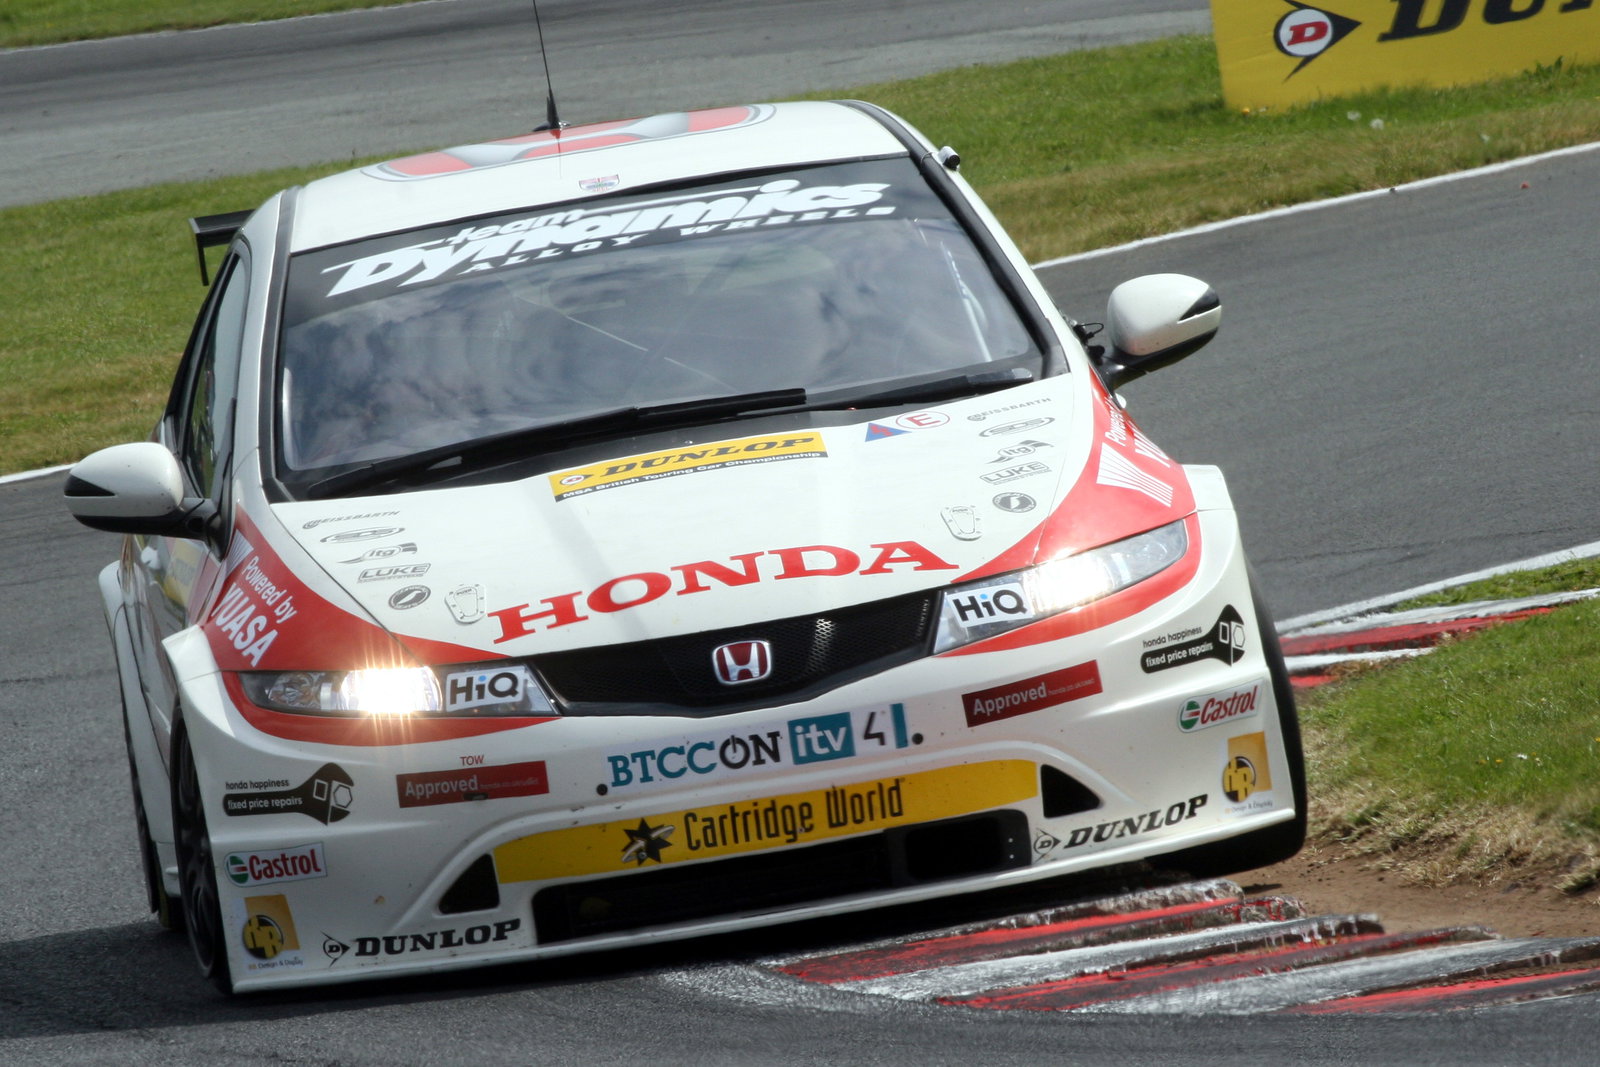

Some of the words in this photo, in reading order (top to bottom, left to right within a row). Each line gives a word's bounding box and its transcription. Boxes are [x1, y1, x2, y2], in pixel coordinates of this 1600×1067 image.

[320, 179, 892, 298] Dynamics
[456, 233, 648, 276] ALLOY
[600, 437, 814, 477] DUNLOP
[983, 464, 1046, 482] LUKE
[563, 487, 592, 498] MSA
[596, 475, 640, 491] British
[642, 466, 694, 482] Touring
[696, 460, 723, 472] Car
[725, 451, 821, 467] Championship
[241, 555, 287, 607] Powered
[274, 595, 297, 624] by
[361, 566, 427, 579] LUKE
[487, 541, 959, 644] HONDA
[952, 589, 1027, 622] HiQ
[210, 582, 278, 668] YUASA
[1143, 636, 1167, 648] honda
[1167, 626, 1202, 642] happiness
[1146, 653, 1166, 667] fixed
[1167, 648, 1188, 664] price
[1188, 642, 1214, 657] repairs
[449, 672, 519, 705] HiQ
[973, 682, 1048, 716] Approved
[1201, 685, 1258, 724] Castrol
[460, 754, 485, 766] TOW
[225, 781, 248, 790] honda
[249, 778, 290, 790] happiness
[405, 775, 478, 799] Approved
[227, 799, 247, 810] fixed
[248, 798, 269, 811] price
[270, 796, 303, 808] repairs
[684, 799, 815, 852] Cartridge
[825, 777, 904, 829] World
[1064, 794, 1208, 848] DUNLOP
[249, 849, 322, 880] Castrol
[355, 918, 521, 957] DUNLOP
